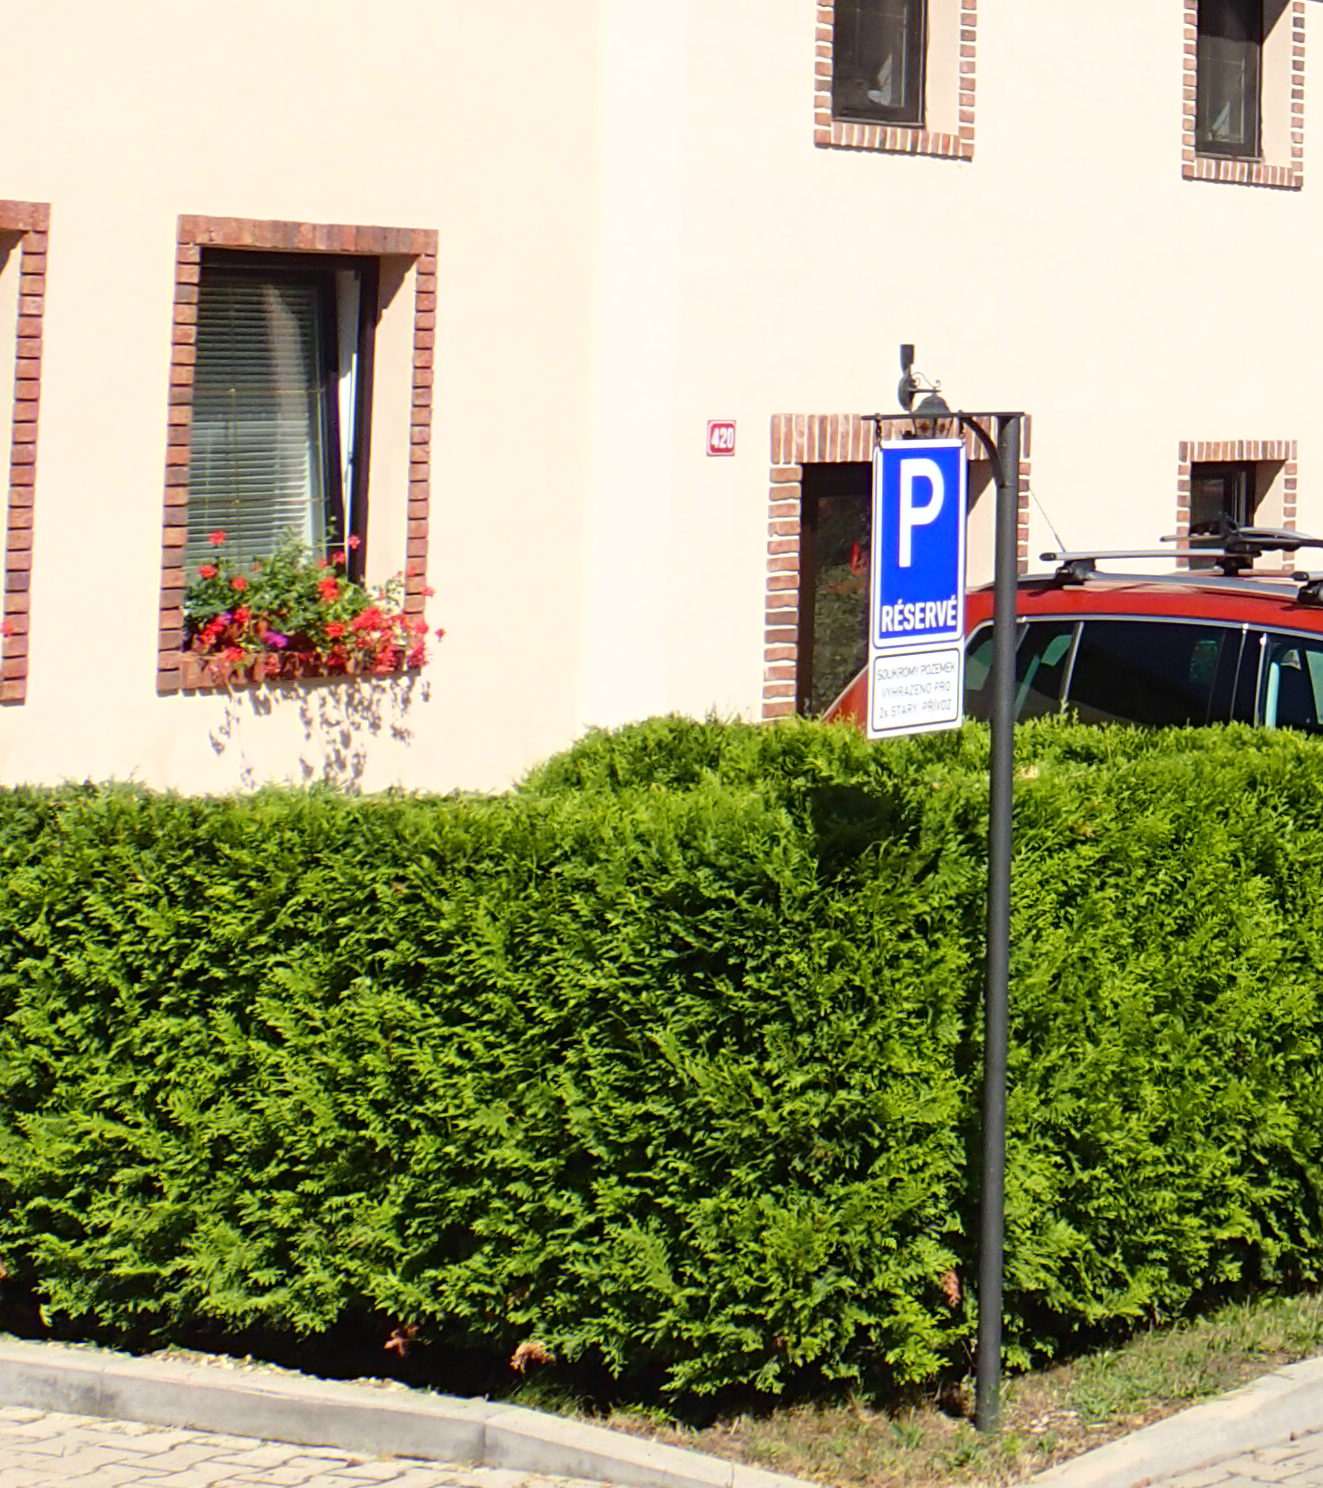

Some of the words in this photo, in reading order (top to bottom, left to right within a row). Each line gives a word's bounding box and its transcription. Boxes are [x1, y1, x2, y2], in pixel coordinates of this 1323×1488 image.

[710, 426, 735, 449] 420
[898, 457, 945, 569] P
[881, 594, 957, 633] RÉSERVÉ
